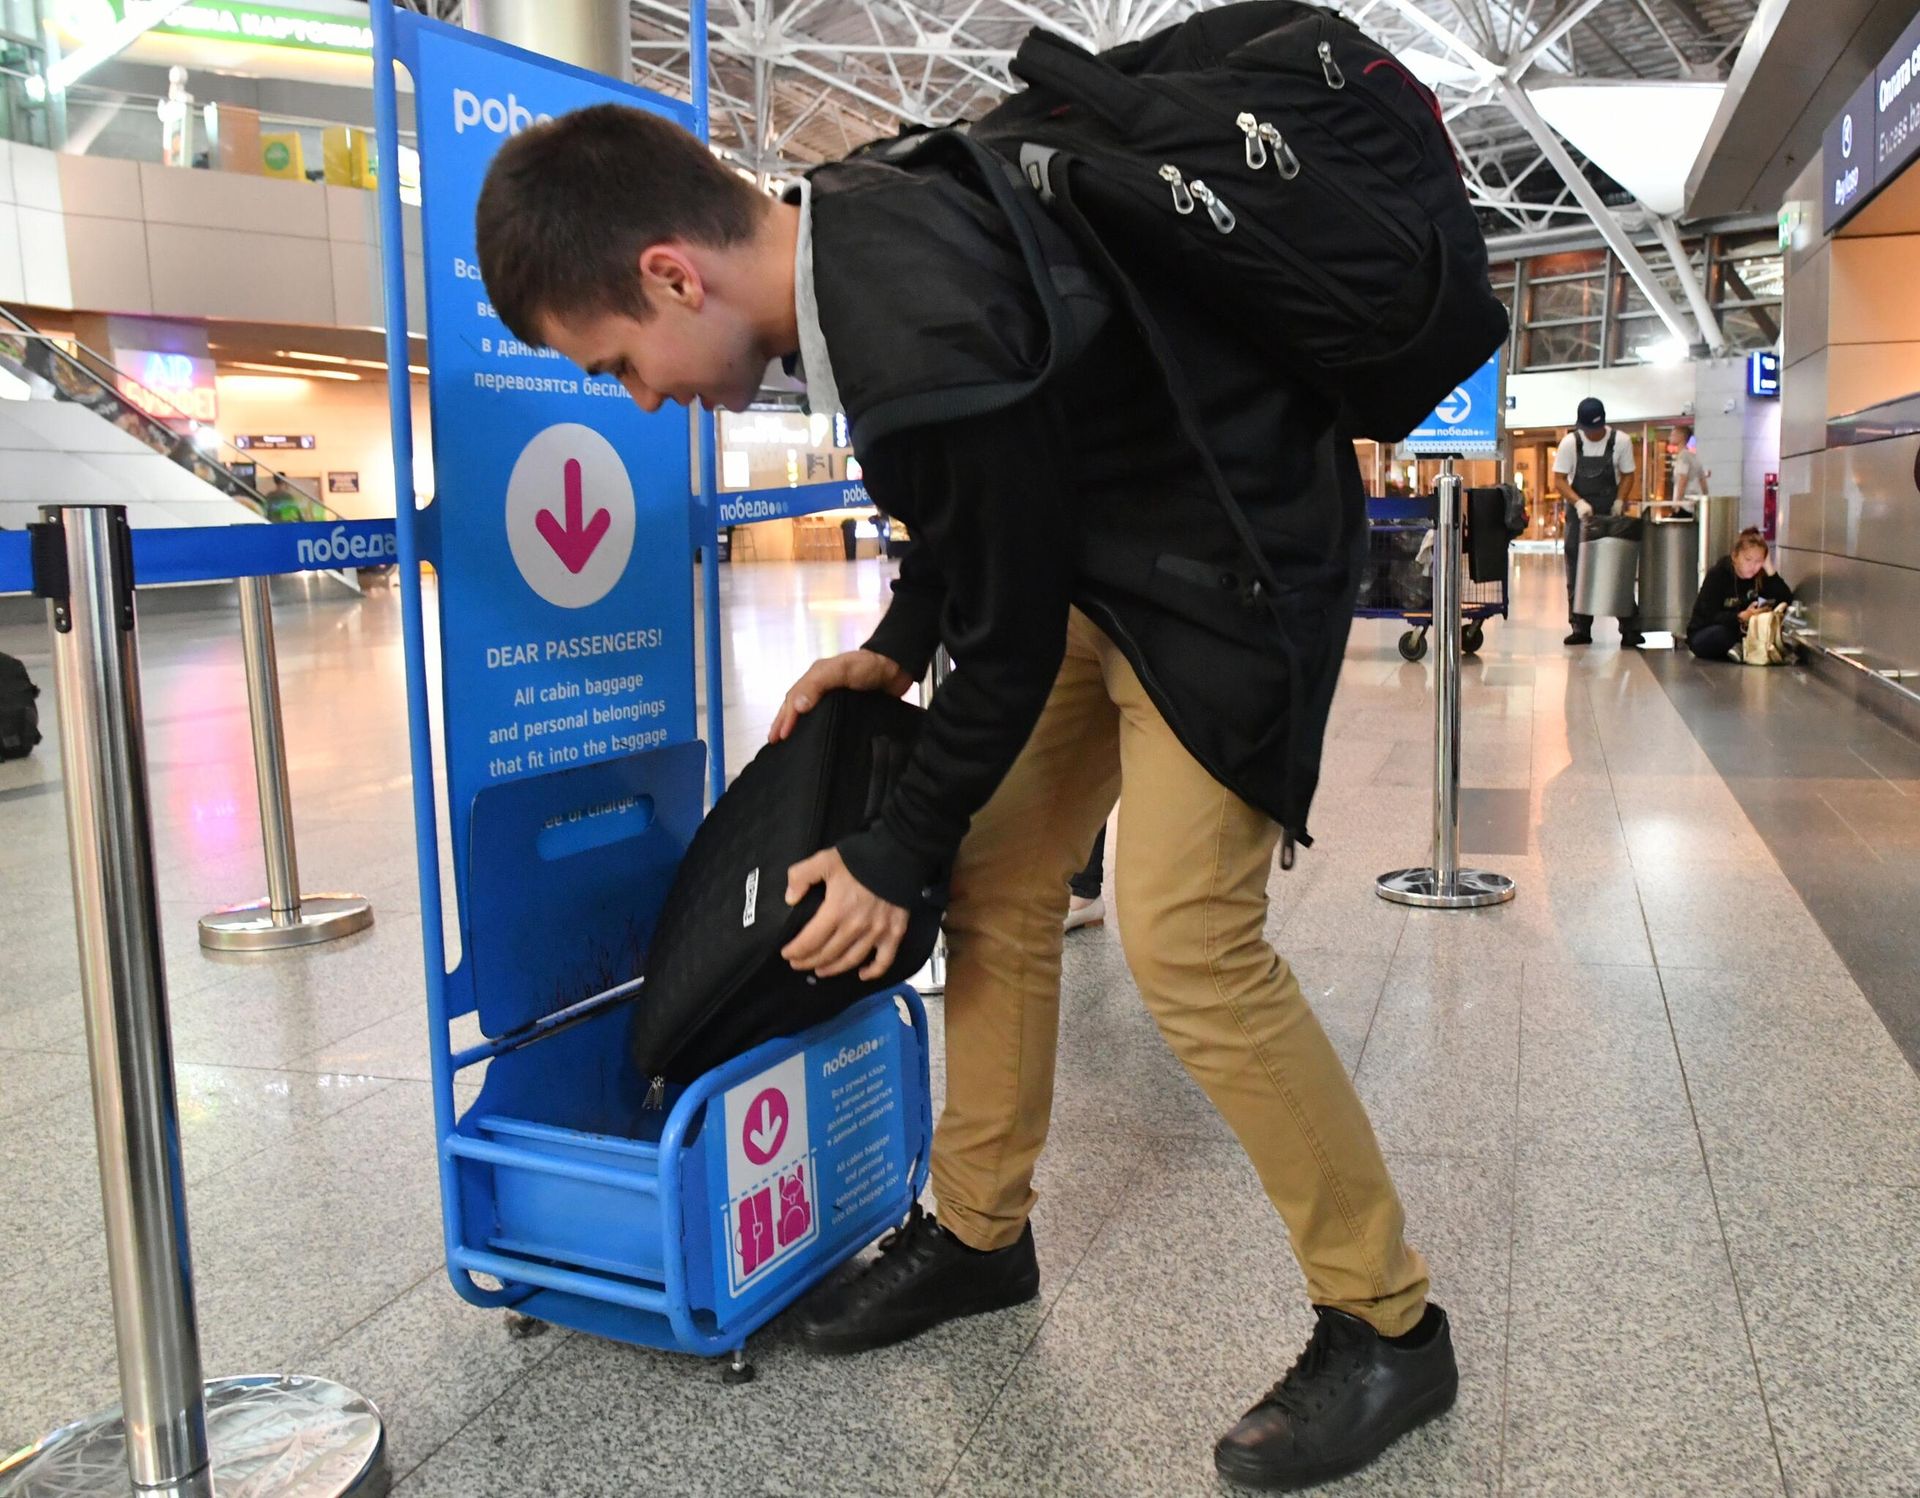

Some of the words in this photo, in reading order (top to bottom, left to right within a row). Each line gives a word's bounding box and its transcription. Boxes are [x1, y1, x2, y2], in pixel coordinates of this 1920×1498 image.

[482, 338, 492, 352] в
[474, 372, 578, 393] перевозятся
[720, 495, 770, 522] победа
[843, 484, 871, 506] pobe
[297, 525, 397, 563] победа
[487, 643, 539, 669] DEAR
[546, 628, 663, 660] PASSENGERS!
[514, 687, 535, 707] All
[540, 682, 580, 703] cabin
[585, 673, 644, 696] baggage
[489, 723, 518, 744] and
[524, 709, 589, 742] personal
[593, 699, 667, 725] belongings
[489, 755, 523, 778] that
[528, 751, 544, 769] fit
[550, 746, 580, 765] into
[583, 739, 607, 758] the
[611, 727, 668, 751] baggage
[823, 1041, 871, 1078] победа
